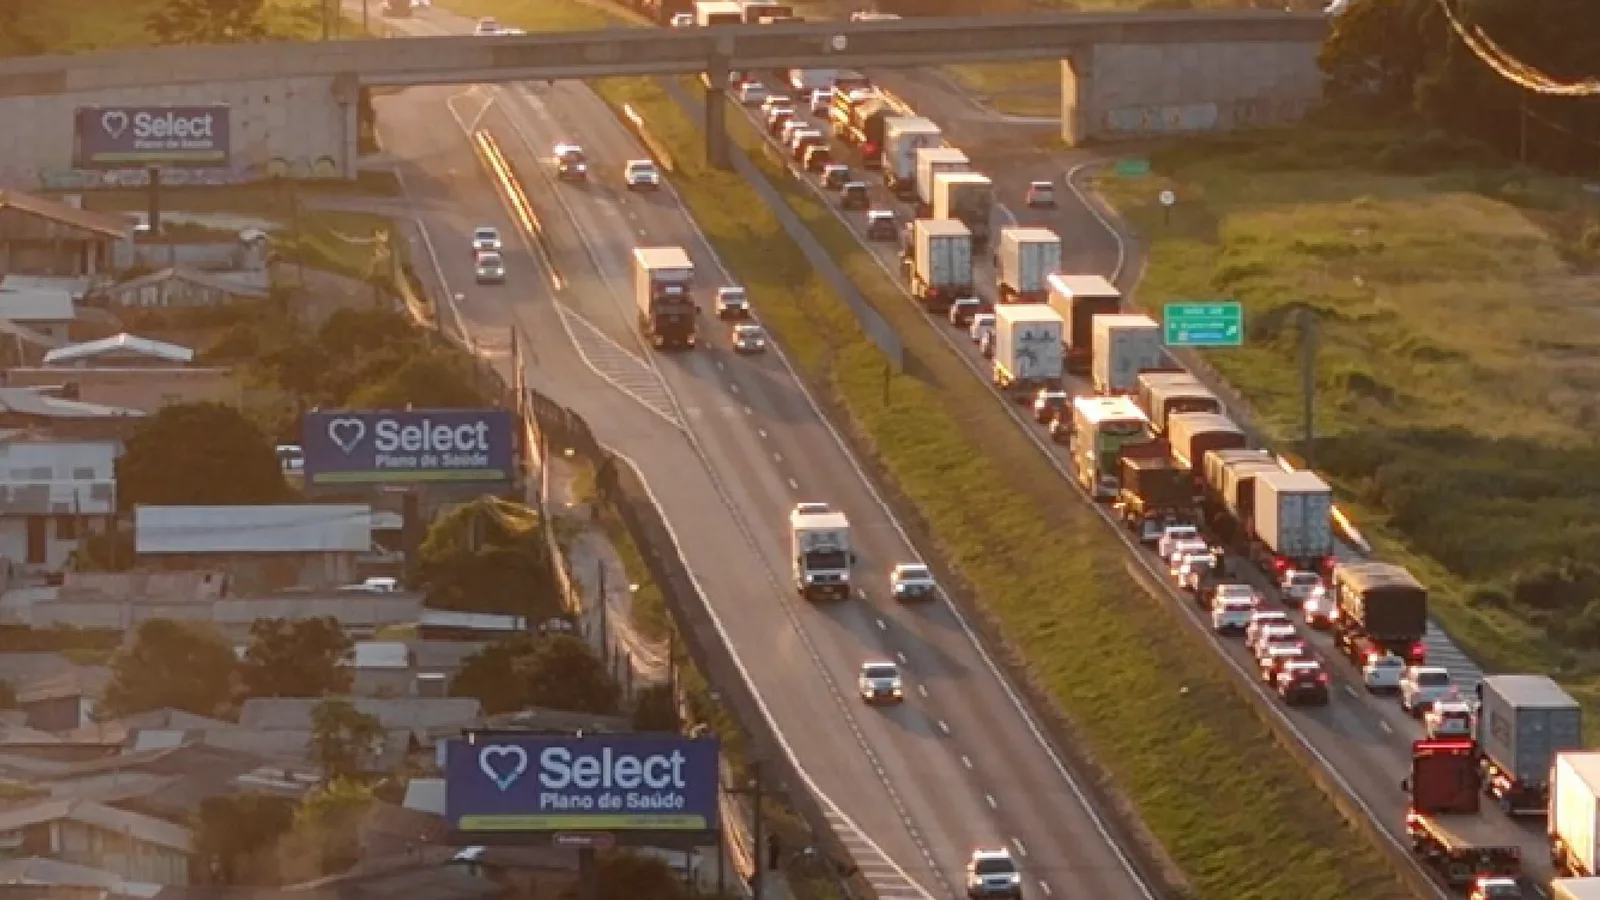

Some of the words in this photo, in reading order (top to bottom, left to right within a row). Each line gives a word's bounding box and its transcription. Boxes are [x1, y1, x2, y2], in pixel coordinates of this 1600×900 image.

[133, 111, 213, 137] Select
[375, 418, 489, 451] Select
[375, 454, 417, 468] Plano
[537, 746, 685, 788] Select
[539, 792, 594, 810] Plano
[597, 791, 622, 809] de
[626, 790, 685, 809] Saúde
